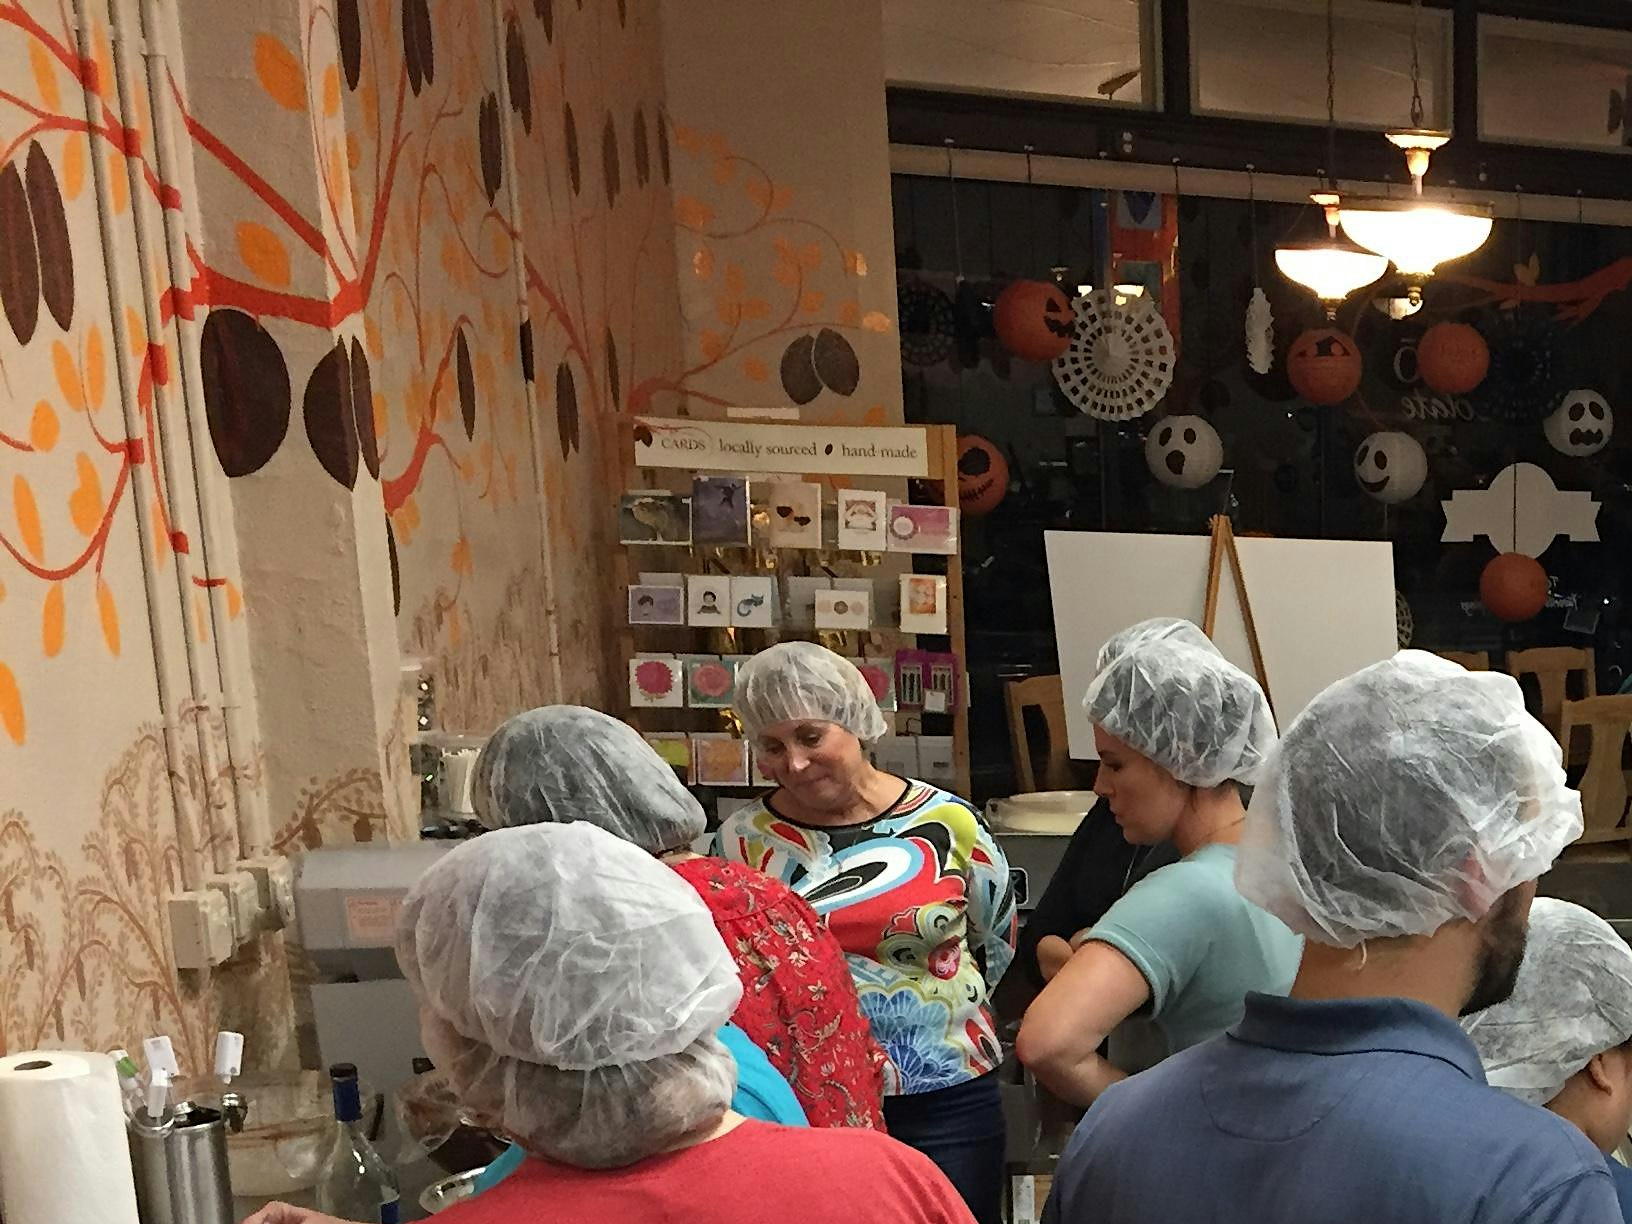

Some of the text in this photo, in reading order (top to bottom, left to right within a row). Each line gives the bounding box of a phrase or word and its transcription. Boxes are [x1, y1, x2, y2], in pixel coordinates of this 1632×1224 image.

[660, 438, 707, 451] CARDS
[719, 440, 761, 458] locally
[765, 442, 817, 457] sourced
